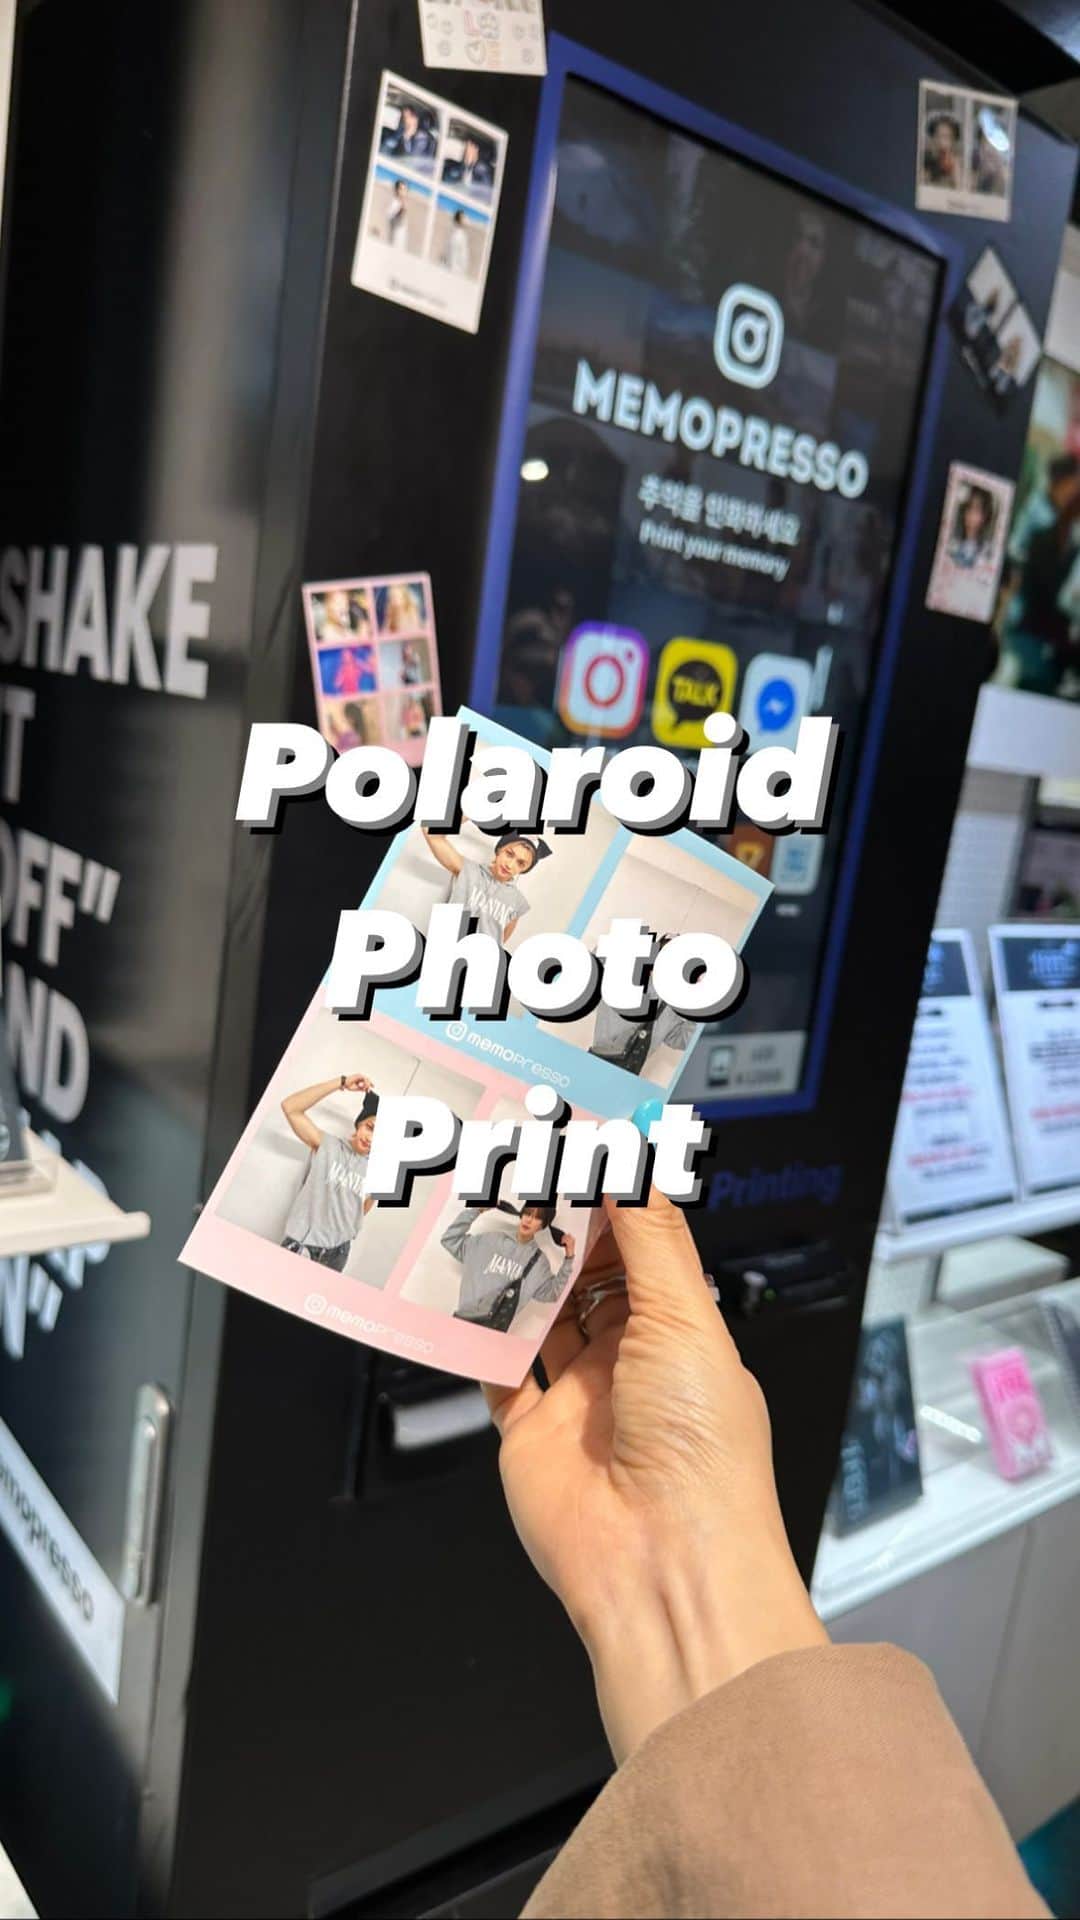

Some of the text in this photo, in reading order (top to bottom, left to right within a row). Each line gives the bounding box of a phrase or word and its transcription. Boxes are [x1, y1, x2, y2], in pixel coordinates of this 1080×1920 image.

[572, 357, 869, 499] MEMOPRESSO
[639, 518, 791, 583] Print your memory
[0, 543, 218, 699] SHAKE
[466, 1032, 570, 1088] memopresso
